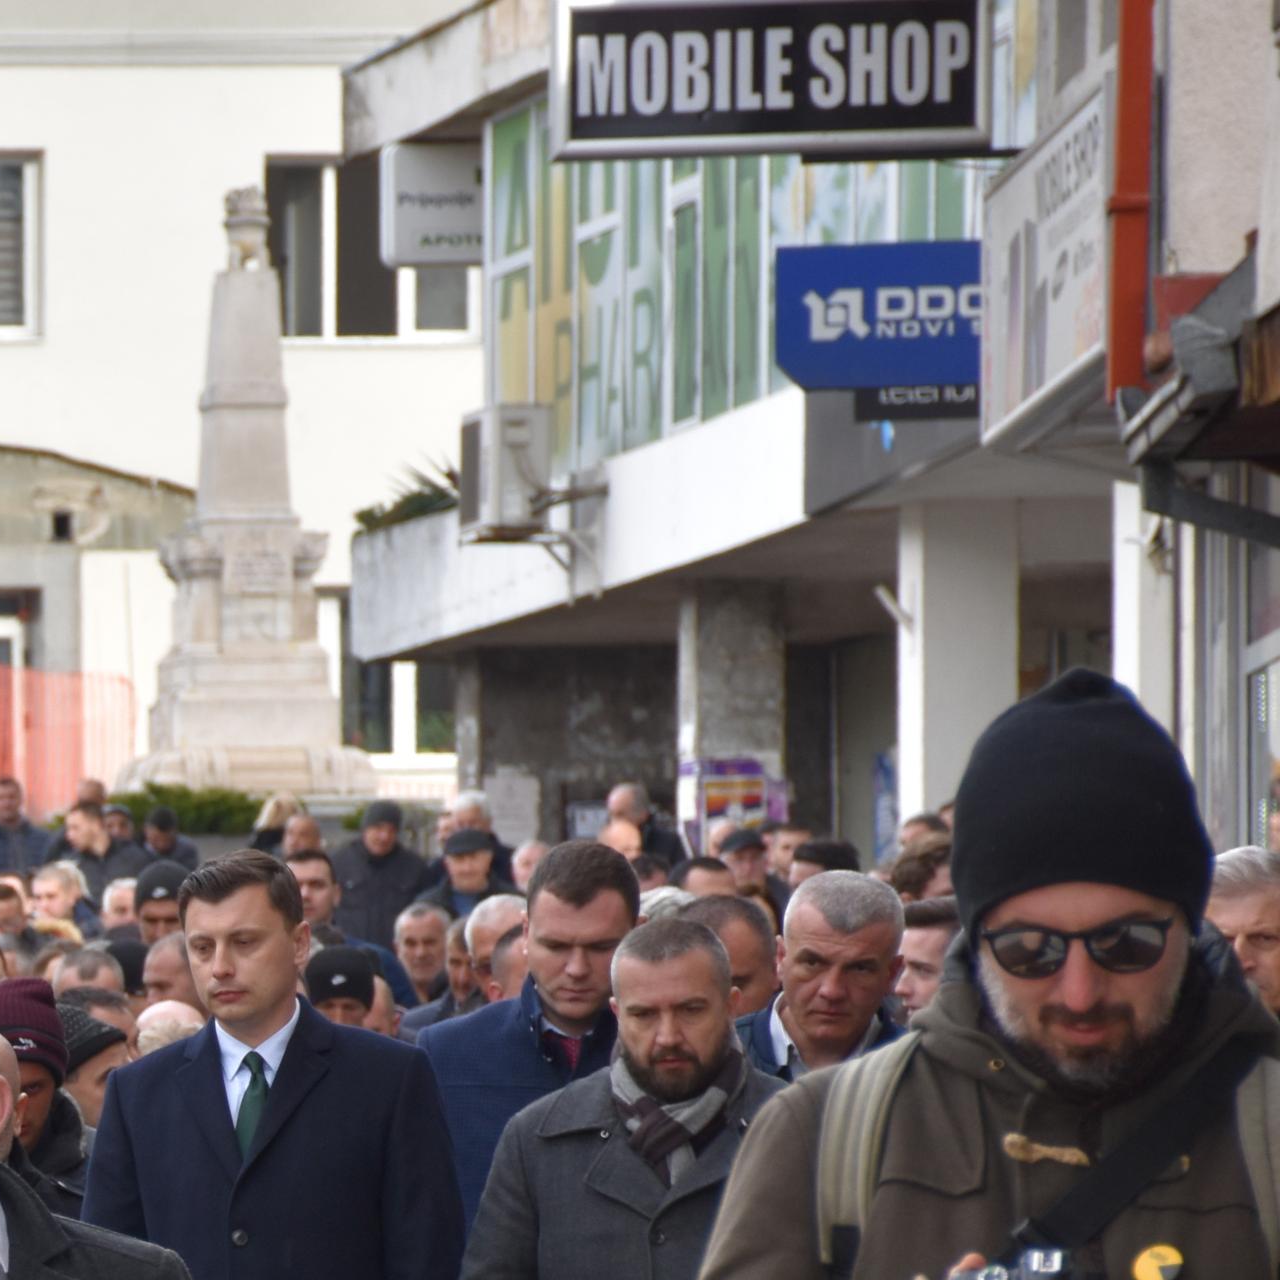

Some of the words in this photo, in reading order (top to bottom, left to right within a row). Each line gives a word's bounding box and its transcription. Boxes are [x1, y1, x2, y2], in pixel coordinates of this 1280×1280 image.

[576, 27, 794, 117] MOBILE
[808, 20, 970, 109] SHOP
[876, 320, 955, 338] NOVI
